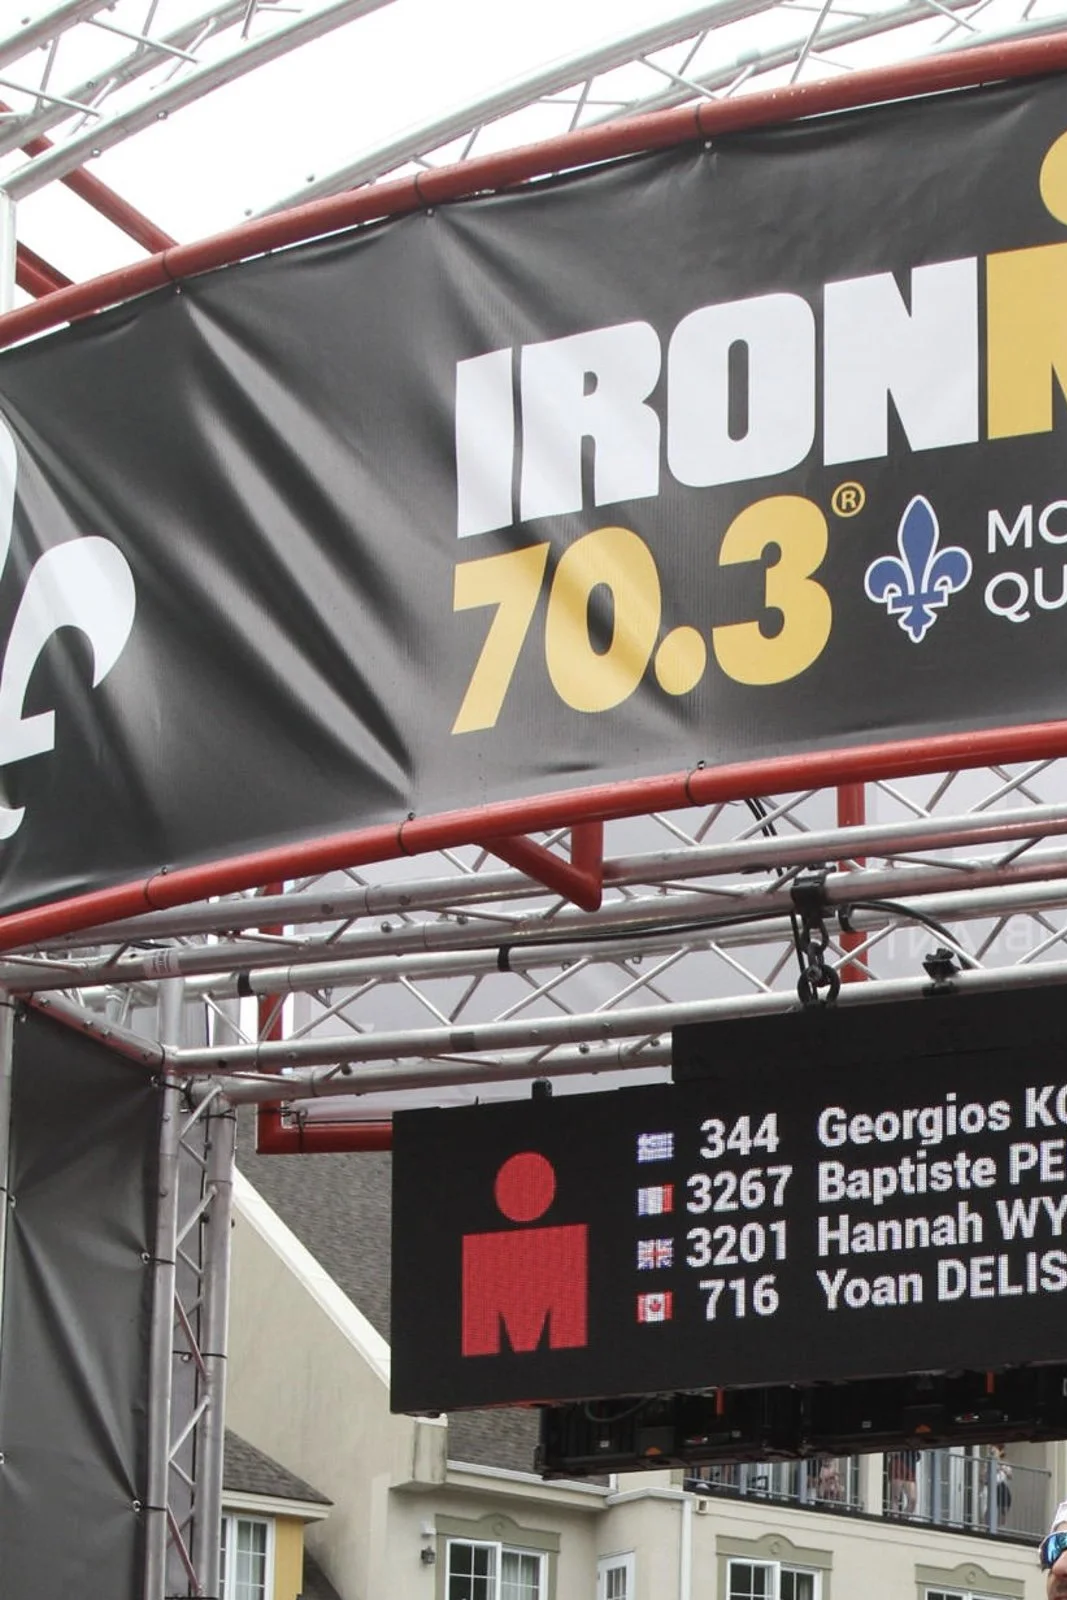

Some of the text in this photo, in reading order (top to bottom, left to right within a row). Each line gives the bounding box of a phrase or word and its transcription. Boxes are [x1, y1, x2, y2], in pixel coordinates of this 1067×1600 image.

[700, 1113, 779, 1159] 344
[817, 1094, 1010, 1147] Georgios
[686, 1165, 793, 1214] 3267
[817, 1150, 997, 1205] Baptiste
[686, 1220, 788, 1268] 3201
[817, 1202, 981, 1256] Hannah
[702, 1274, 779, 1320] 716
[817, 1269, 923, 1310] Yoan
